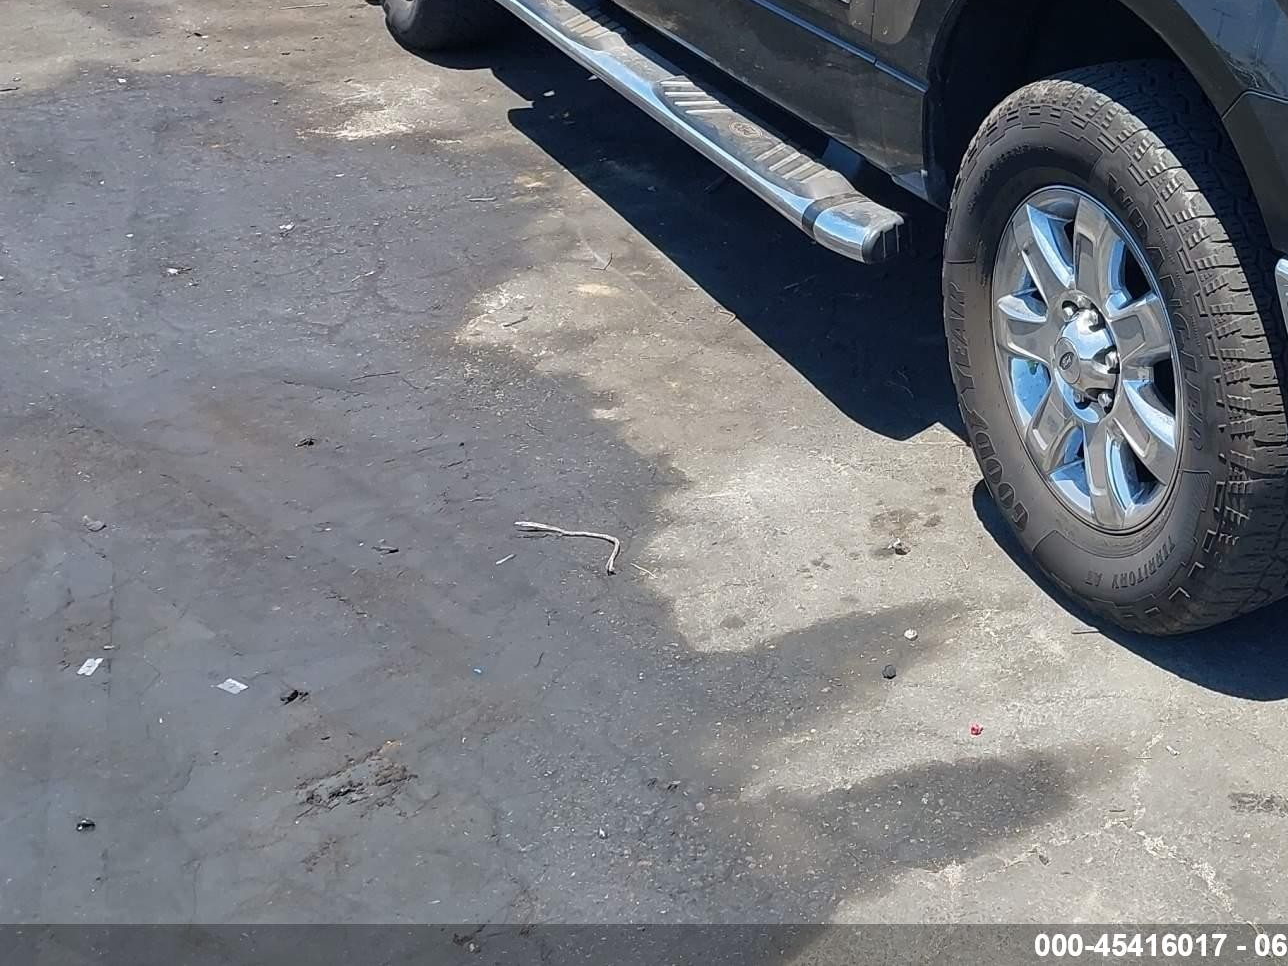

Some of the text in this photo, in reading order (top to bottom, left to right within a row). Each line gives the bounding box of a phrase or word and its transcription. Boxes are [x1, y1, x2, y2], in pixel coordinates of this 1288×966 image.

[949, 281, 1029, 532] GOODYEAR
[1084, 535, 1176, 590] TERRITORY AT
